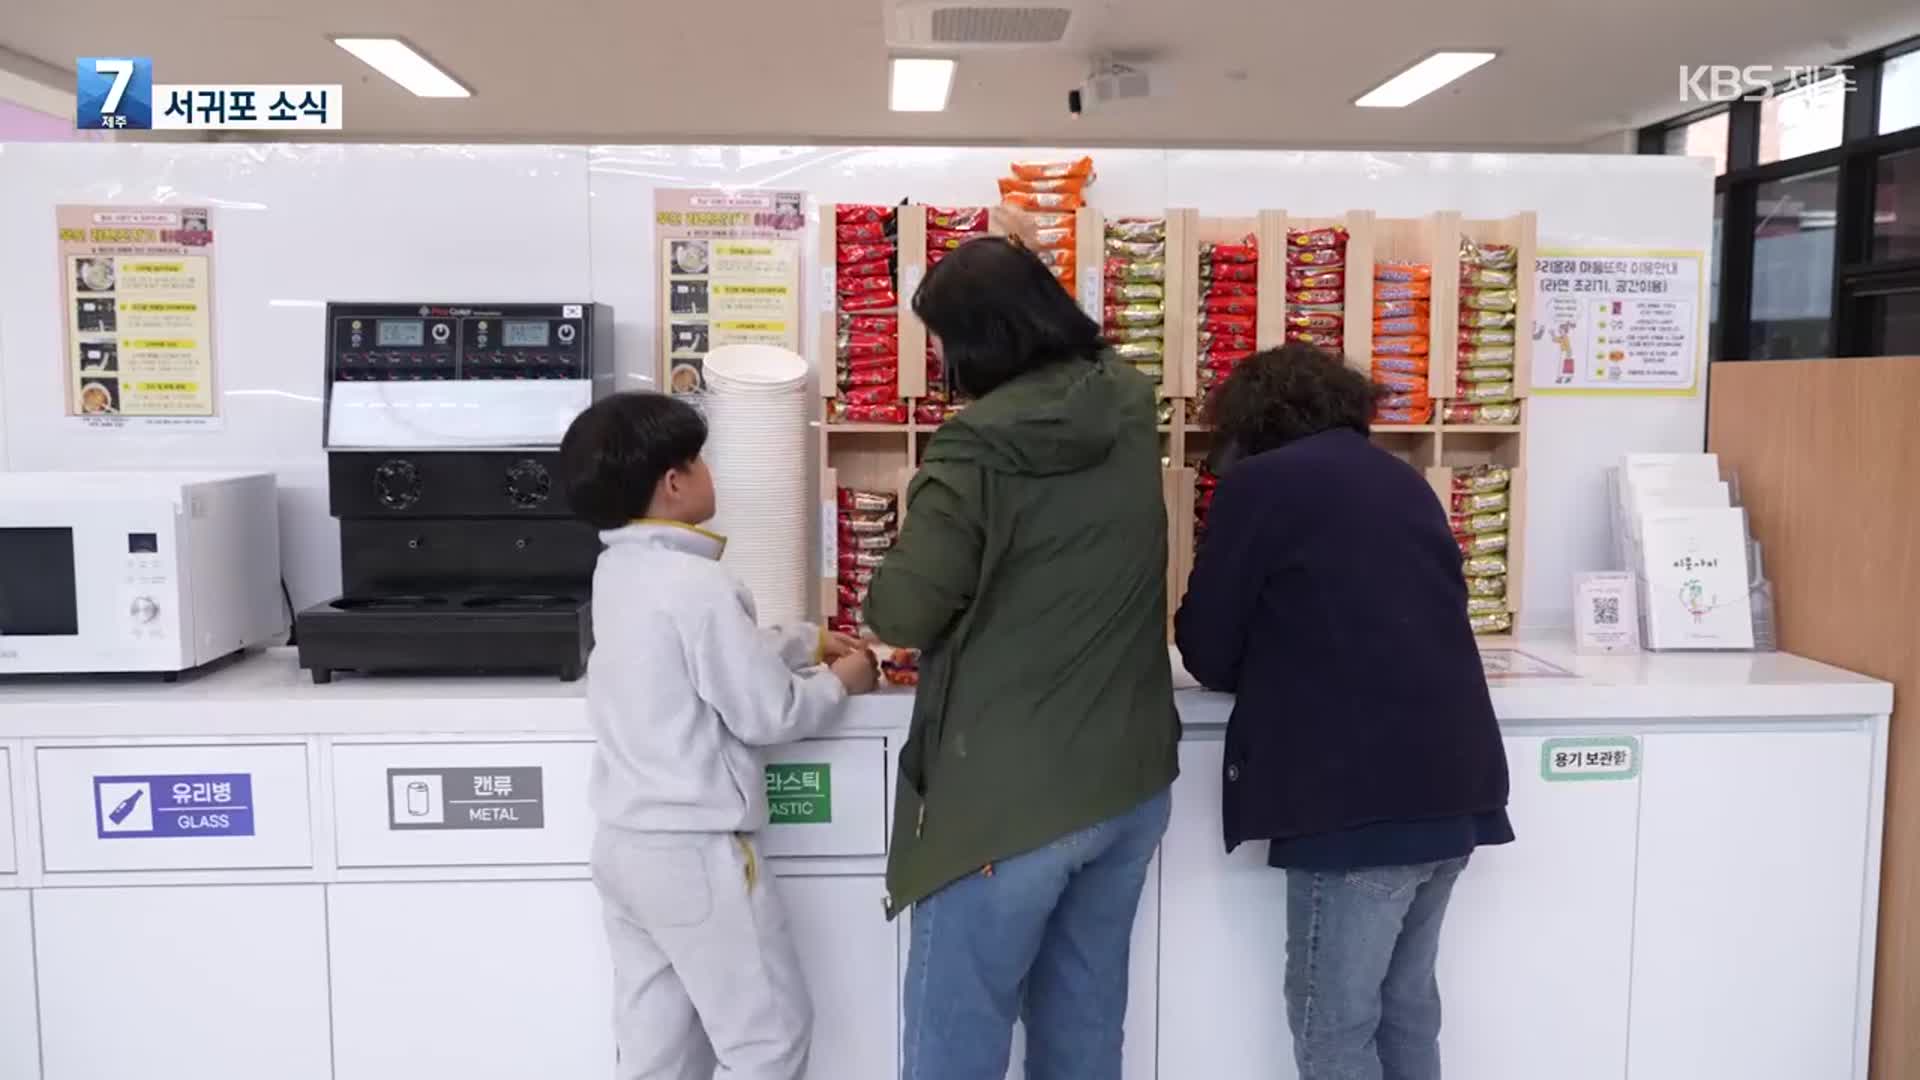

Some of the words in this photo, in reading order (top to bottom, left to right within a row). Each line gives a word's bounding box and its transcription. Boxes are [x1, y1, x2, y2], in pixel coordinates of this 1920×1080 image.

[1540, 280, 1569, 292] (라면
[1554, 751, 1582, 768] 용기
[1585, 750, 1627, 766] 보관함
[473, 775, 513, 796] 캔류
[766, 771, 820, 792] 라스틱
[172, 782, 232, 804] 유리병
[469, 808, 518, 821] METAL
[770, 801, 814, 816] ASTIC
[177, 814, 230, 828] GLASS
